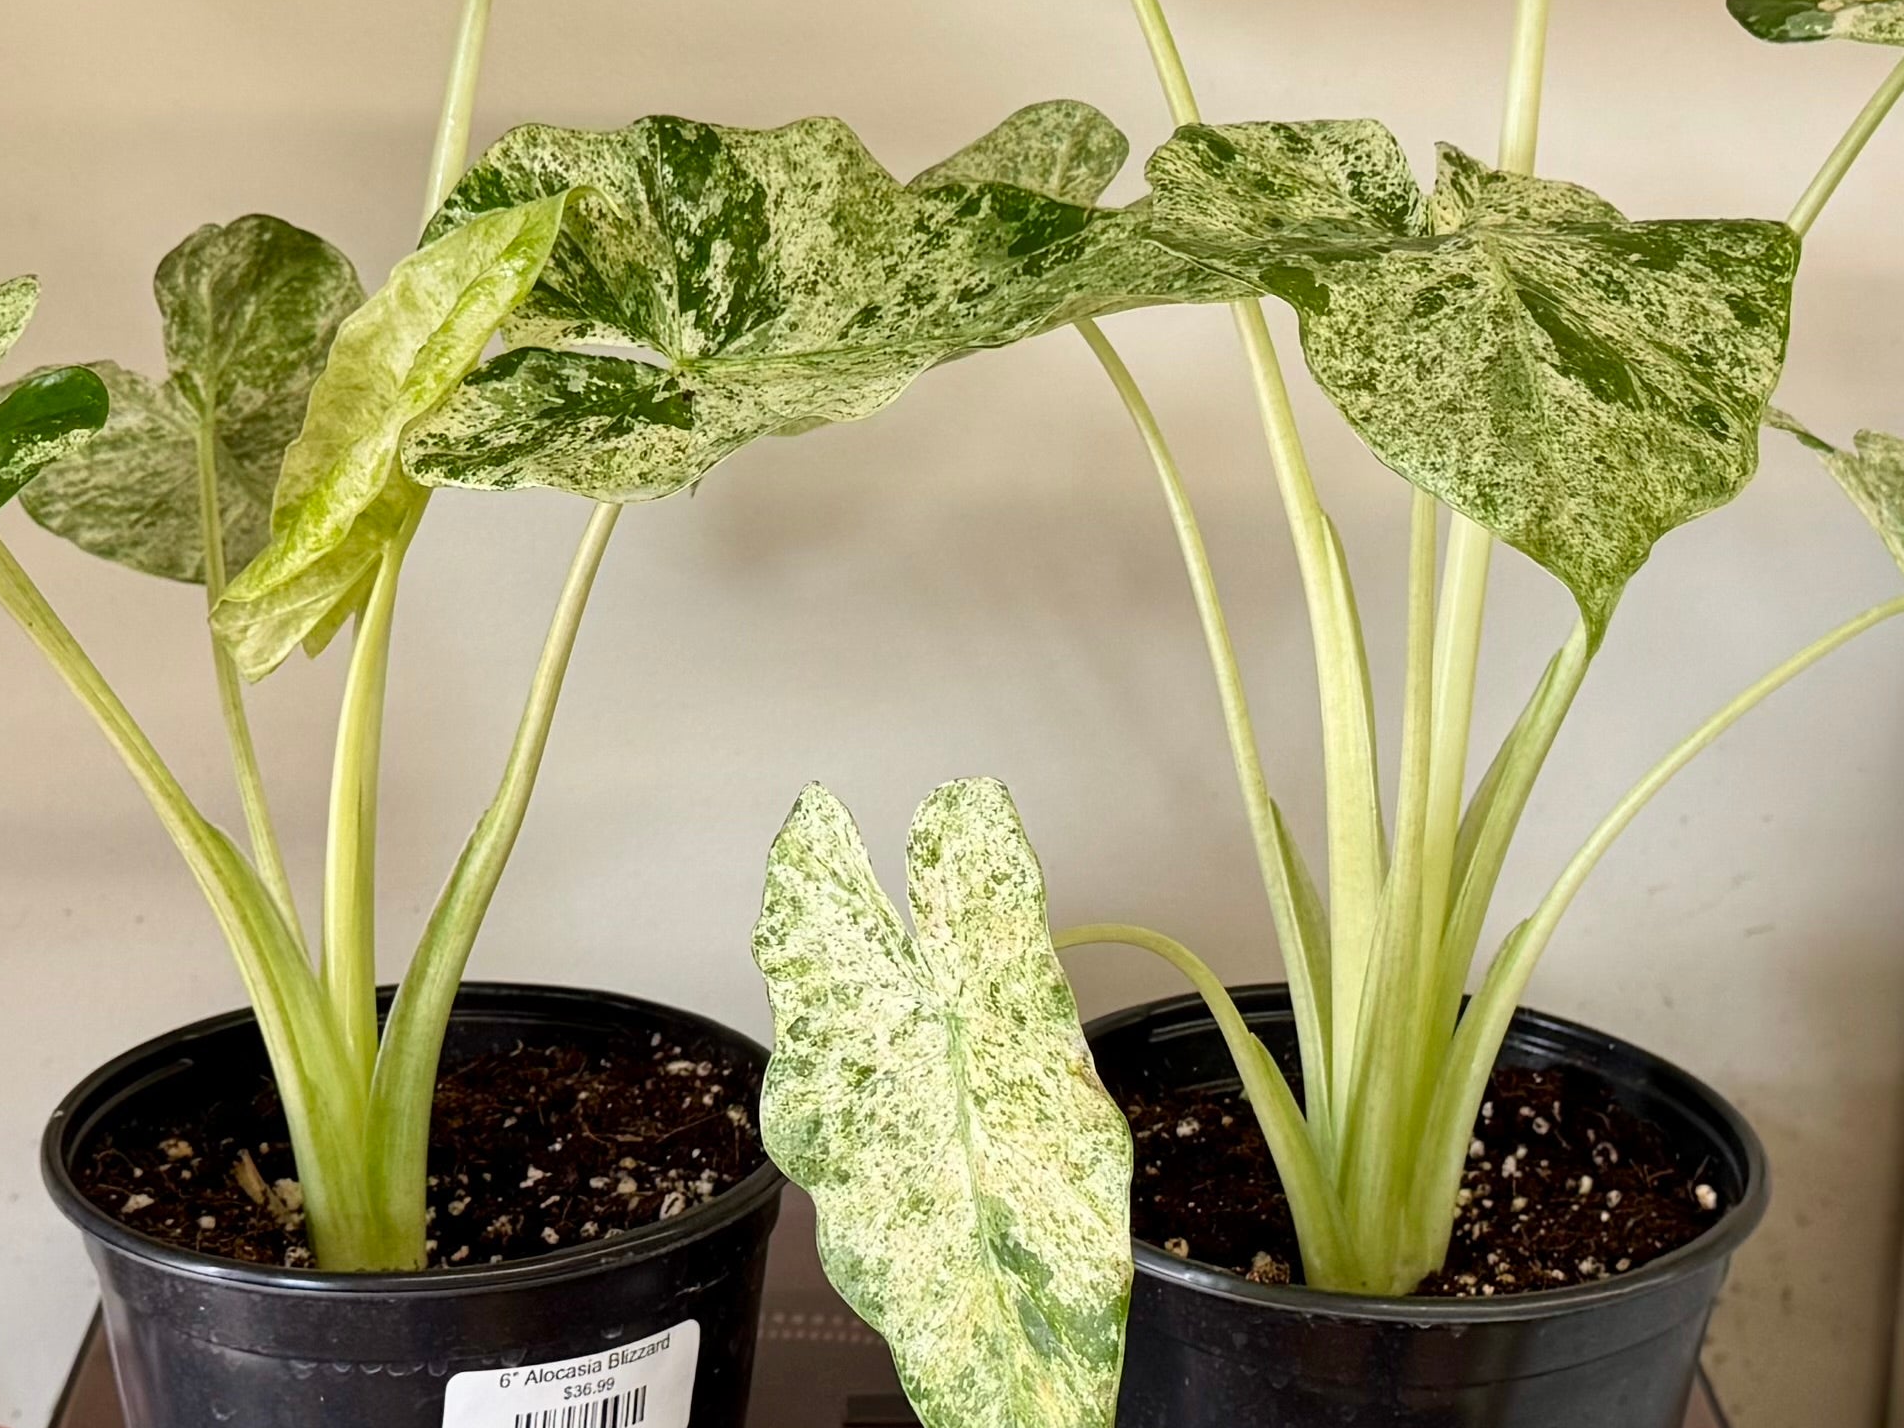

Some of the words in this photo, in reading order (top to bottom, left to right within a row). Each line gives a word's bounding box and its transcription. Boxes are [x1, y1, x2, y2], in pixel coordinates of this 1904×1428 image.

[524, 1359, 602, 1387] Alocasia
[608, 1333, 671, 1370] Blizzard
[563, 1377, 616, 1400] $36.99
